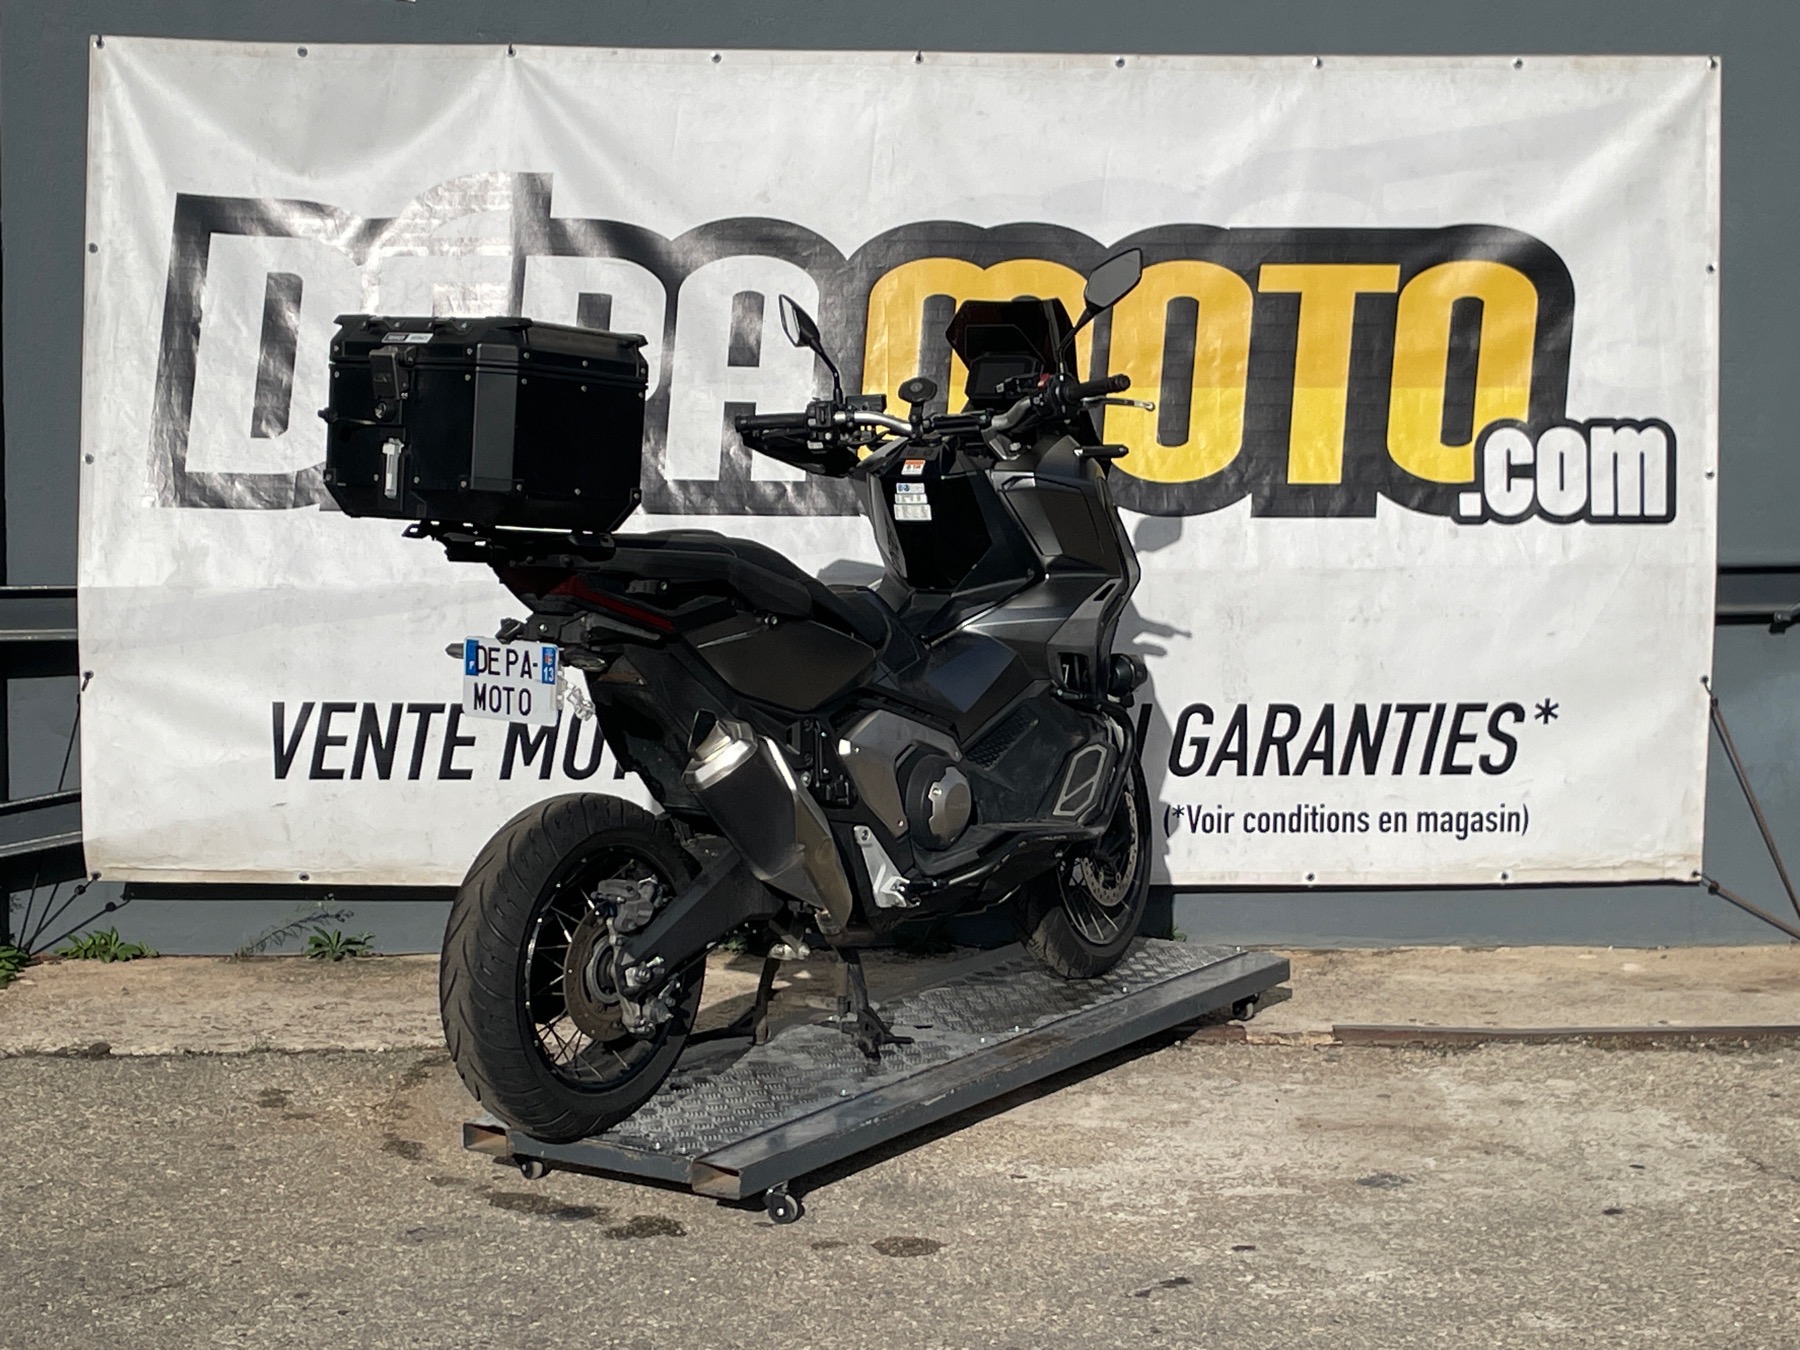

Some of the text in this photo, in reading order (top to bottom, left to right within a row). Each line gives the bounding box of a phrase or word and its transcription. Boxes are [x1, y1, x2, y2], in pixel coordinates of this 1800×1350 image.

[476, 644, 538, 679] DEPA-
[543, 666, 555, 682] 13
[473, 682, 532, 716] MOTO
[271, 701, 477, 780] VENTE
[1242, 803, 1370, 834] conditions
[1378, 813, 1407, 833] en
[1416, 803, 1530, 841] magasin)
